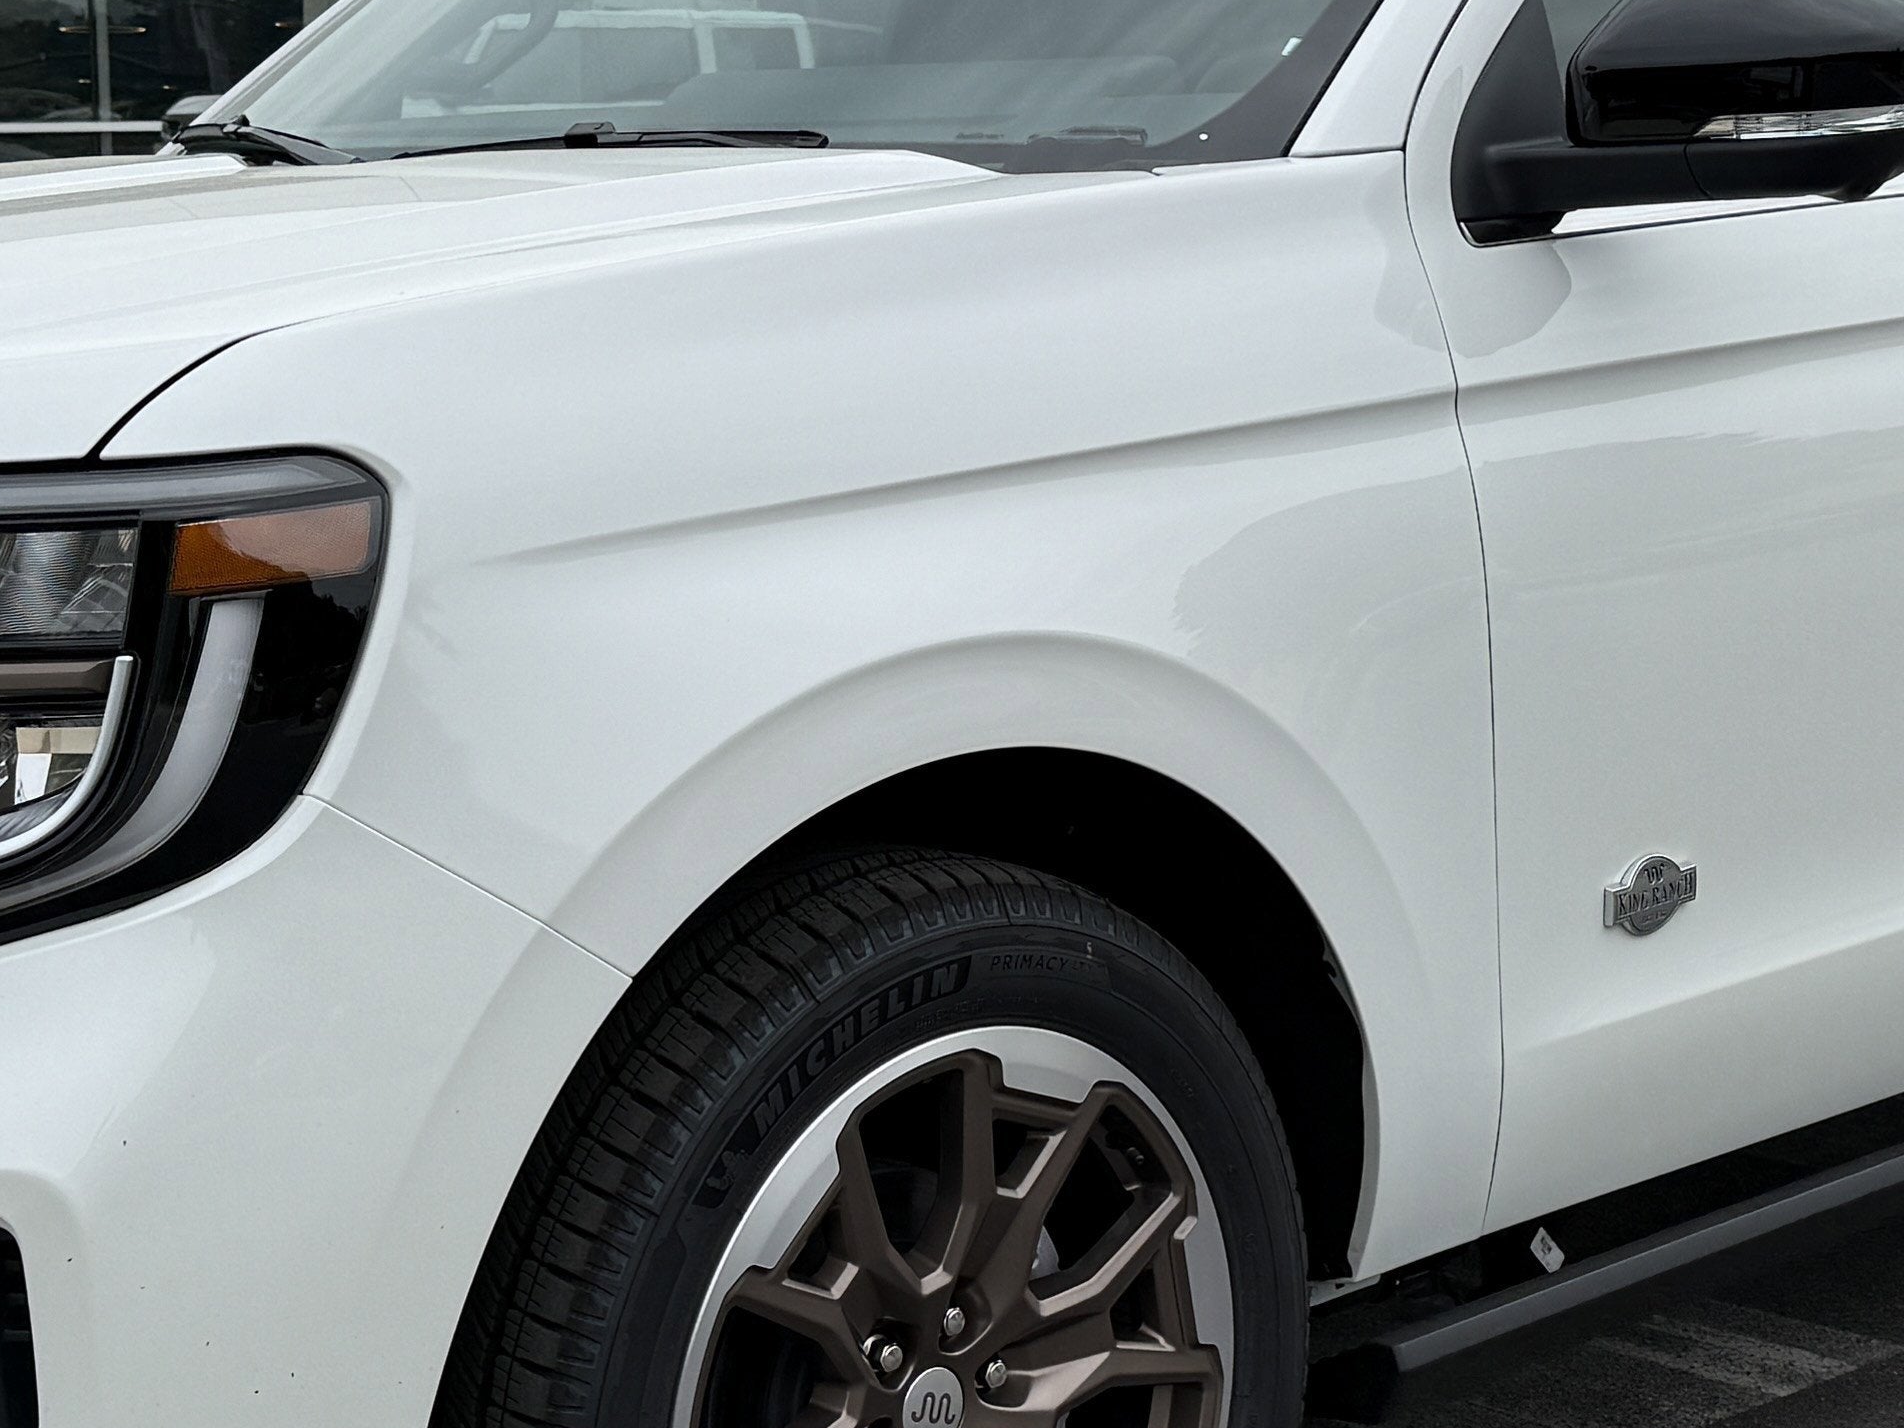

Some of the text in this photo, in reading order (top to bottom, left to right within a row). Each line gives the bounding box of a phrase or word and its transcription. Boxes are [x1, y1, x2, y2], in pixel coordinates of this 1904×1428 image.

[1618, 871, 1695, 916] KING RANCH
[753, 963, 958, 1138] MICHELIN
[989, 954, 1070, 973] PRIMACY
